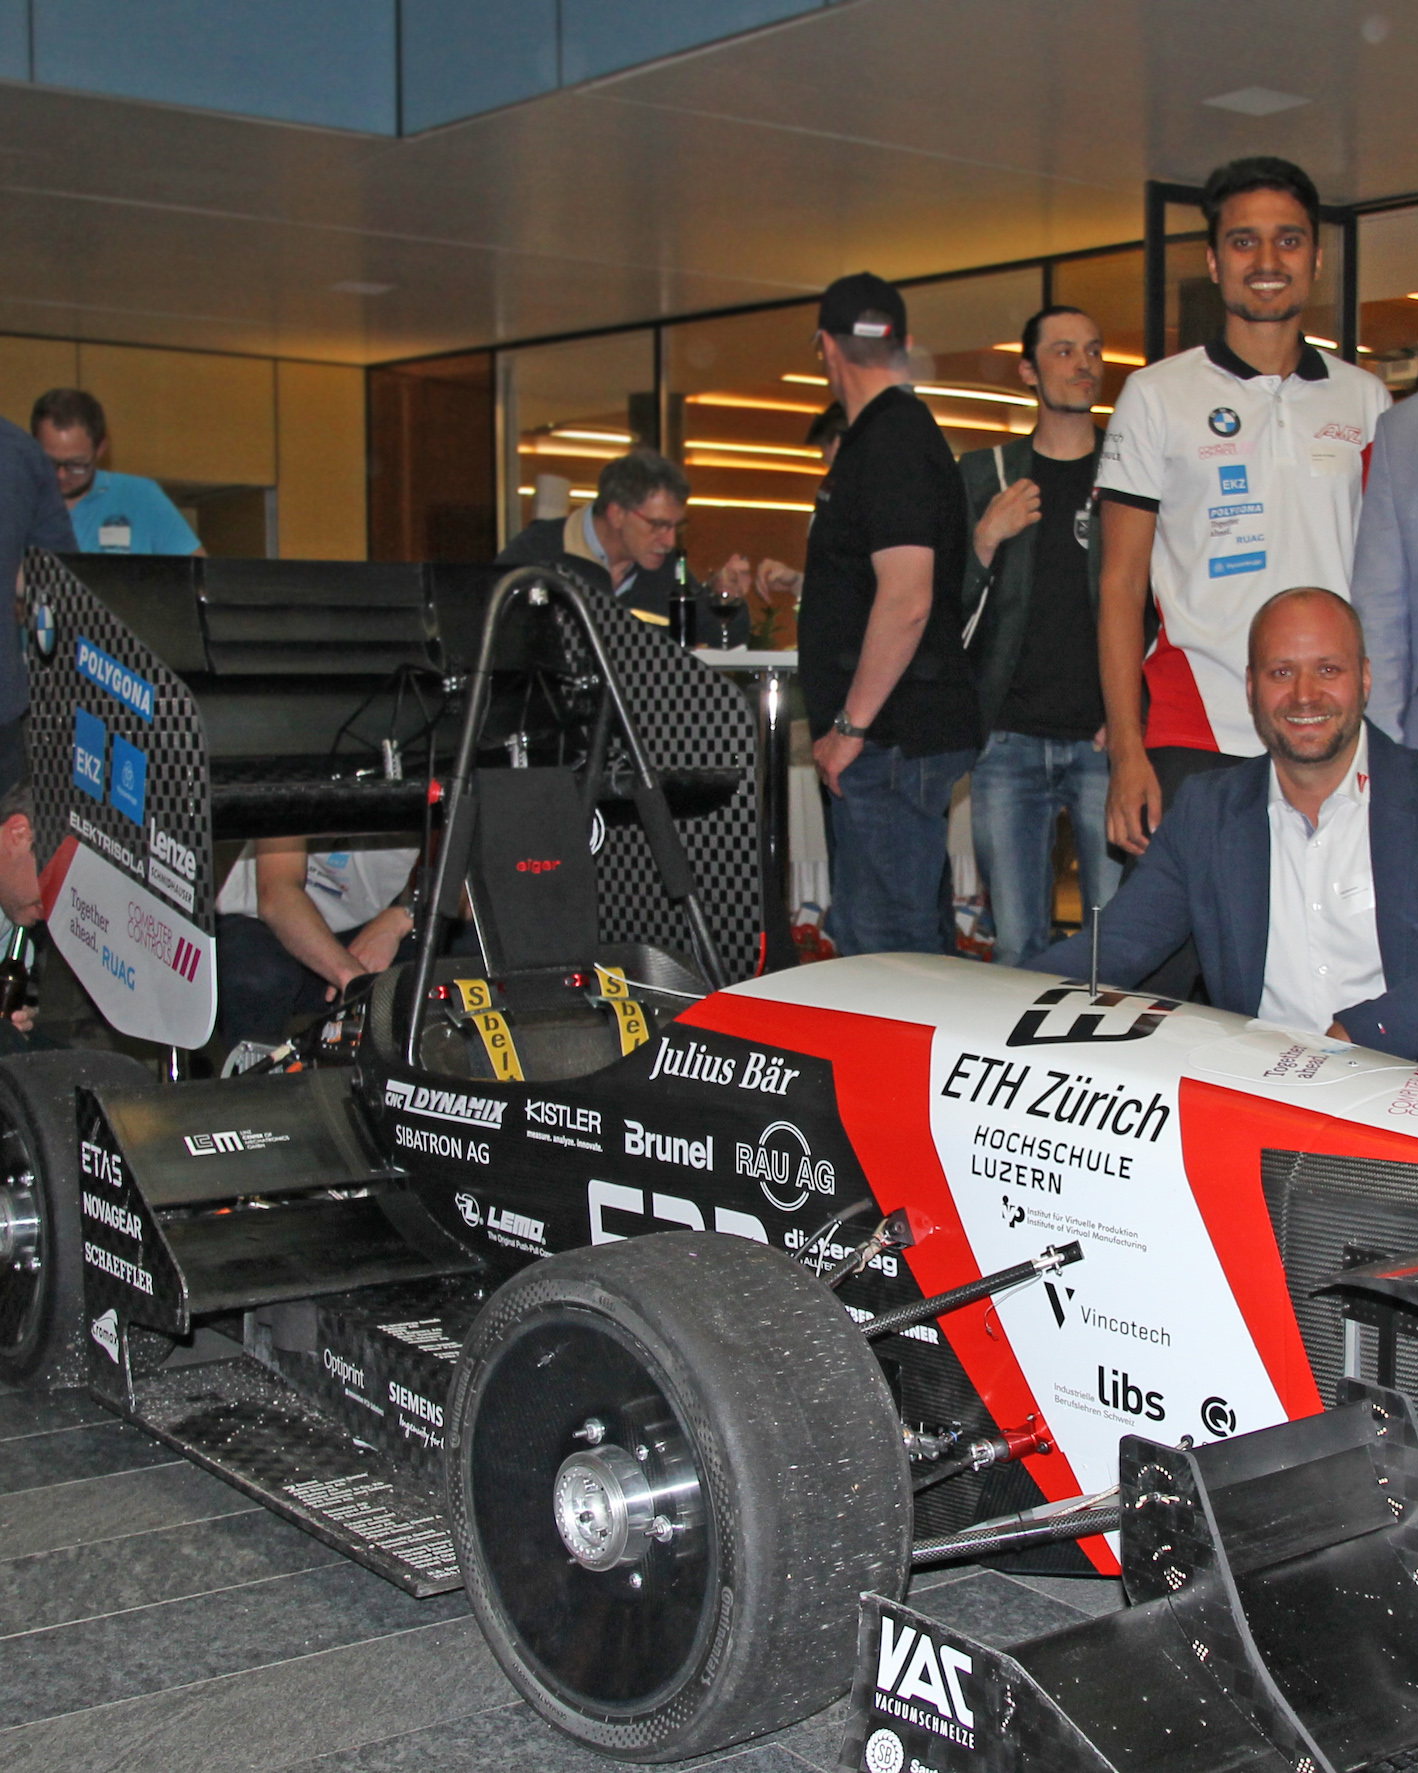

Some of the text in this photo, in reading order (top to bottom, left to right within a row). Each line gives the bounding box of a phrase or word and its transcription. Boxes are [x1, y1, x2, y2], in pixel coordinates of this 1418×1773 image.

[1222, 479, 1246, 490] EKZ
[1236, 534, 1264, 544] RUAG
[78, 644, 151, 716] POLYGONA
[76, 747, 101, 785] EKZ
[69, 811, 145, 878] ELEKTRISOLA
[150, 817, 196, 881] Lenze
[151, 866, 192, 903] SCHMIDHAUSER
[516, 858, 561, 874] eiger
[71, 887, 109, 933] Together
[128, 901, 172, 947] COMPUTER
[70, 919, 98, 953] ahead.
[128, 917, 172, 967] CONTROLS
[102, 945, 135, 991] RUAG
[649, 1037, 800, 1096] Julius Bär
[1263, 1045, 1307, 1079] Together
[385, 1087, 508, 1123] CNC DYNAMIX
[524, 1099, 602, 1134] KISTLER
[940, 1052, 1170, 1142] ETH Zürich
[82, 1141, 123, 1188] ETAS
[396, 1124, 490, 1164] SIBATRON AG
[624, 1119, 714, 1171] Brunel
[973, 1124, 1133, 1180] HOCHSCHULE
[736, 1142, 835, 1195] RAU AG
[971, 1154, 1062, 1195] LUZERN
[83, 1191, 142, 1241] NOVAGEAR
[487, 1206, 545, 1243] LEMO
[1027, 1207, 1138, 1239] Institut für Virtuelle Produktion
[1027, 1217, 1148, 1252] Institute of Virtual Manufacturing
[85, 1241, 153, 1295] SCHAEFFLER
[868, 1254, 898, 1278] ag
[1081, 1305, 1171, 1347] Vincotech
[324, 1348, 364, 1389] Optiprint
[388, 1381, 444, 1428] SIEMENS
[1054, 1383, 1095, 1403] Industrielle
[1054, 1395, 1135, 1427] Berufslehren Schweiz
[1098, 1365, 1165, 1422] libs
[399, 1413, 430, 1448] Ingenuity
[877, 1615, 974, 1729] VAC
[875, 1691, 976, 1750] VACUUMSCHMELZE
[877, 1743, 892, 1764] SB
